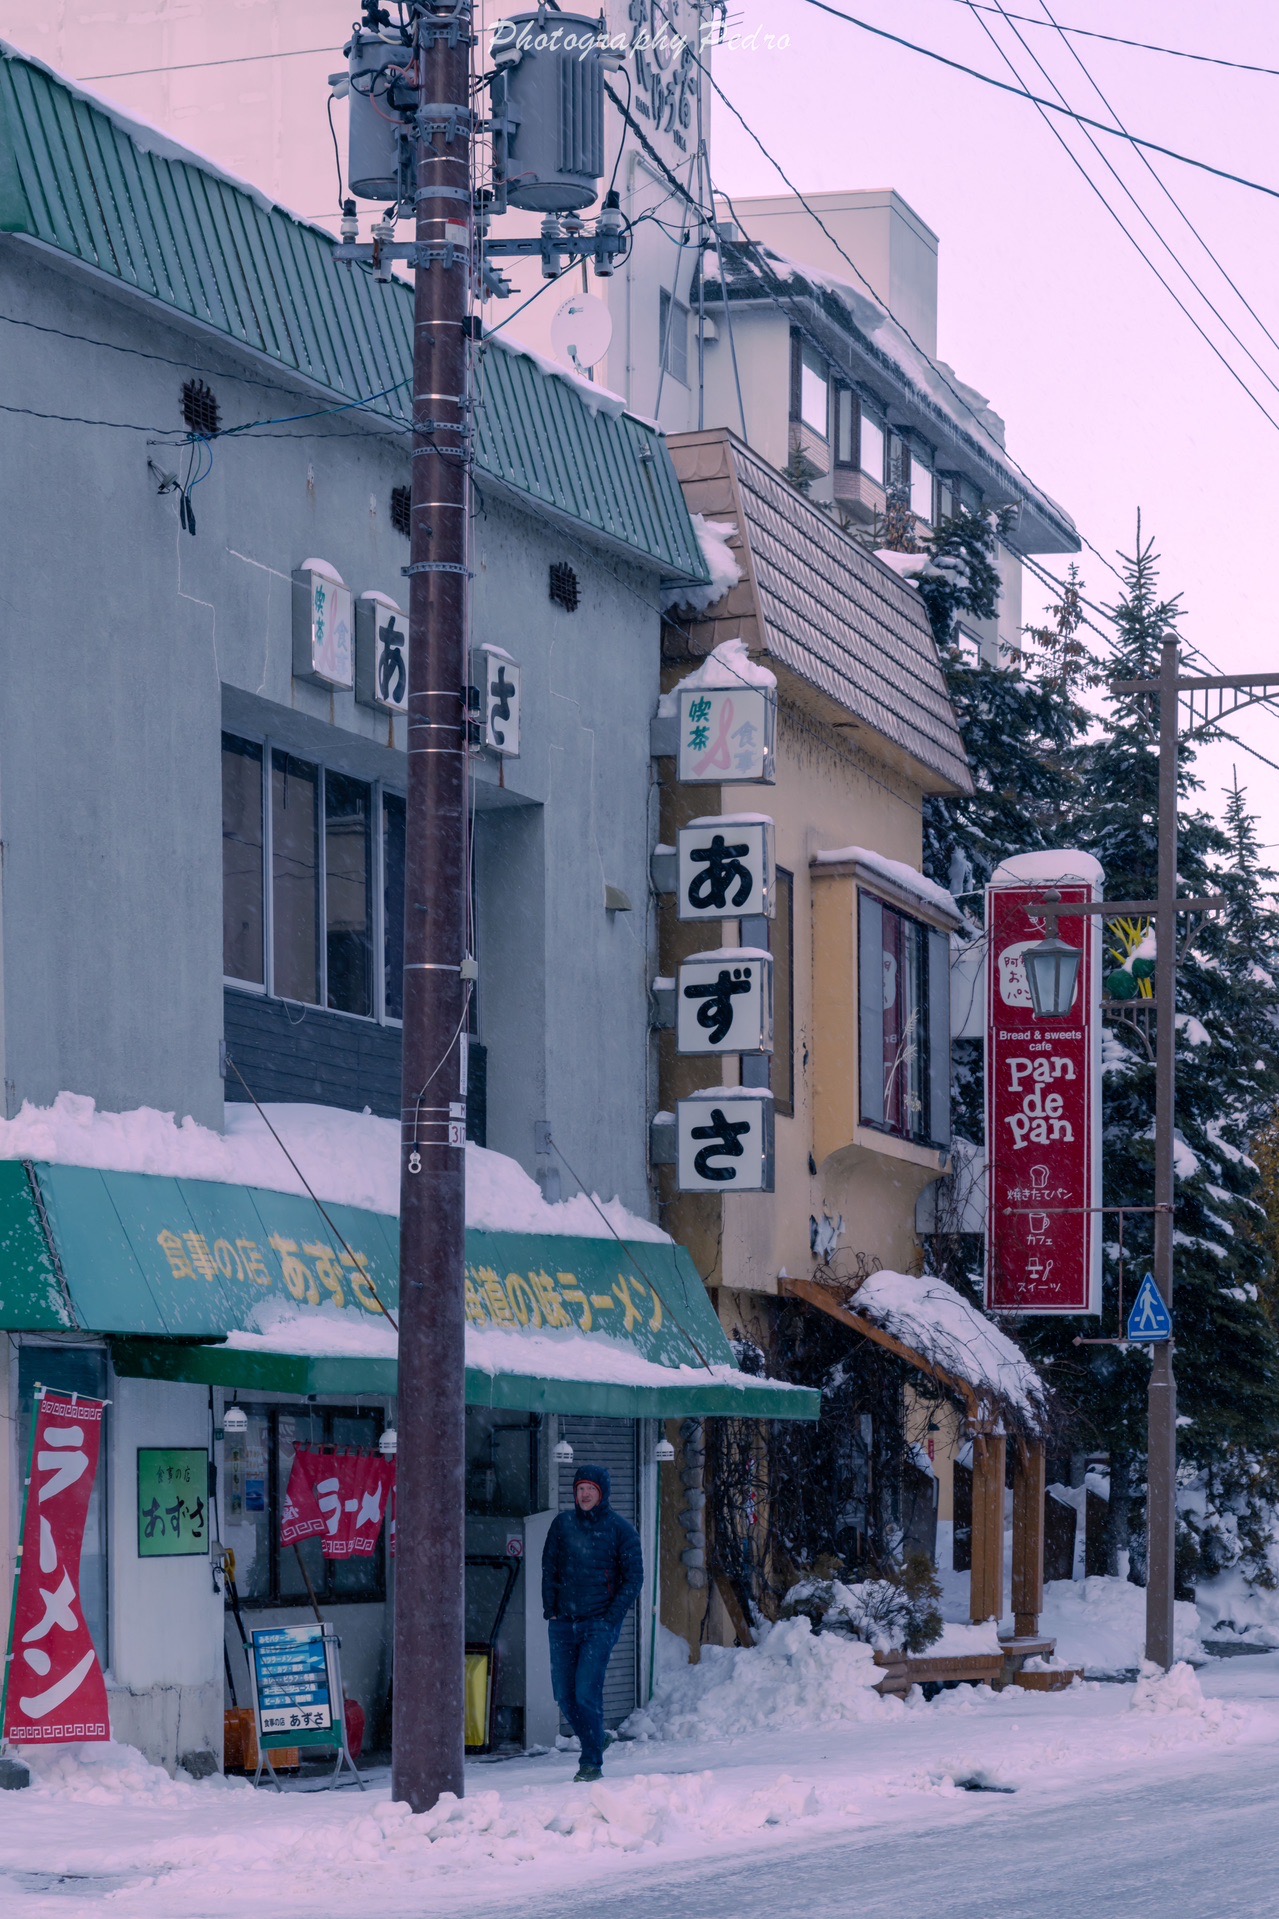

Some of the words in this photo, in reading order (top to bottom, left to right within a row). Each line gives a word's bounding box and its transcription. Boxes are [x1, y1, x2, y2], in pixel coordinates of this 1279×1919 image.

[379, 615, 407, 704] あ
[490, 665, 516, 746] さ
[687, 695, 712, 751] 喫茶
[730, 720, 759, 775] 食事
[687, 835, 754, 909] あ
[684, 967, 752, 1044] ず
[999, 1030, 1031, 1040] Bread
[1033, 1030, 1042, 1040] &
[1044, 1030, 1082, 1040] sweets
[1029, 1041, 1052, 1051] cafe
[1022, 1082, 1064, 1118] de
[691, 1108, 751, 1181] さ
[1007, 1187, 1073, 1201] 焼きたてパン
[1026, 1234, 1053, 1246] カフェ
[157, 1229, 272, 1287] 食事の店
[268, 1231, 384, 1313] あずさ
[1017, 1282, 1062, 1292] スイーツ
[142, 1496, 205, 1538] あずさ
[20, 1425, 95, 1719] ラーメン
[263, 1718, 286, 1728] 食事の店
[289, 1711, 324, 1727] あずさ
